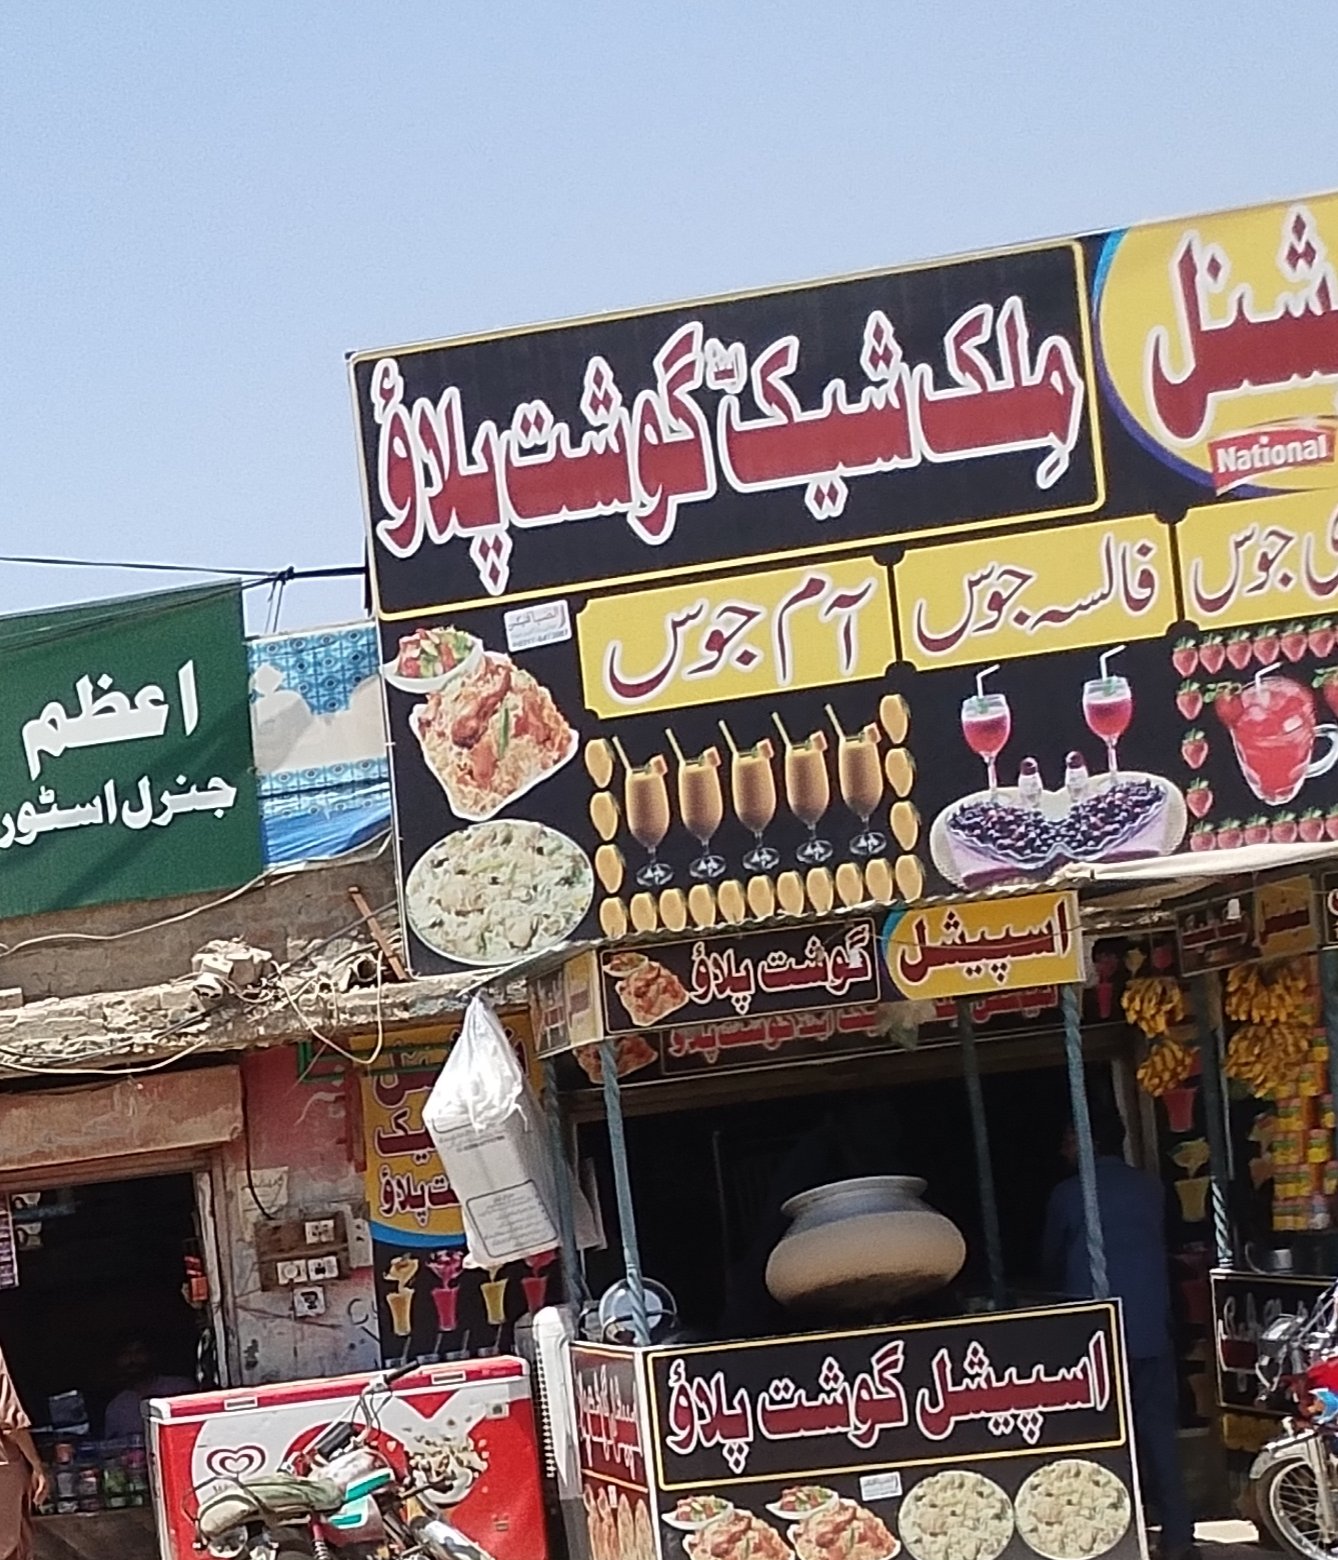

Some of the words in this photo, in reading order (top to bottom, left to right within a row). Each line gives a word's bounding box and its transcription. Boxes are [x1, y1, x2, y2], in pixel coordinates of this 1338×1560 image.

[1143, 205, 1338, 448] شنل
[498, 321, 717, 545] گوشت
[717, 311, 921, 520] شیک
[1215, 434, 1328, 474] National
[372, 358, 512, 595] پلاؤ
[913, 562, 1036, 656] جوس
[1028, 532, 1160, 634] فالسہ
[1191, 522, 1296, 615] جوس
[602, 597, 765, 706] جوس
[770, 572, 878, 687] آم
[22, 660, 198, 781] اعظم
[0, 779, 117, 848] اسٹور
[122, 774, 237, 829] جنرل
[689, 941, 756, 1015] پلاؤ
[757, 924, 873, 996] گوشت
[898, 897, 1071, 985] اسپیشل
[375, 1108, 437, 1165] یک
[379, 1165, 429, 1227] پلاؤ
[665, 1359, 754, 1474] پلاؤ
[757, 1340, 908, 1449] گوشت
[916, 1331, 1111, 1444] اسپیشل
